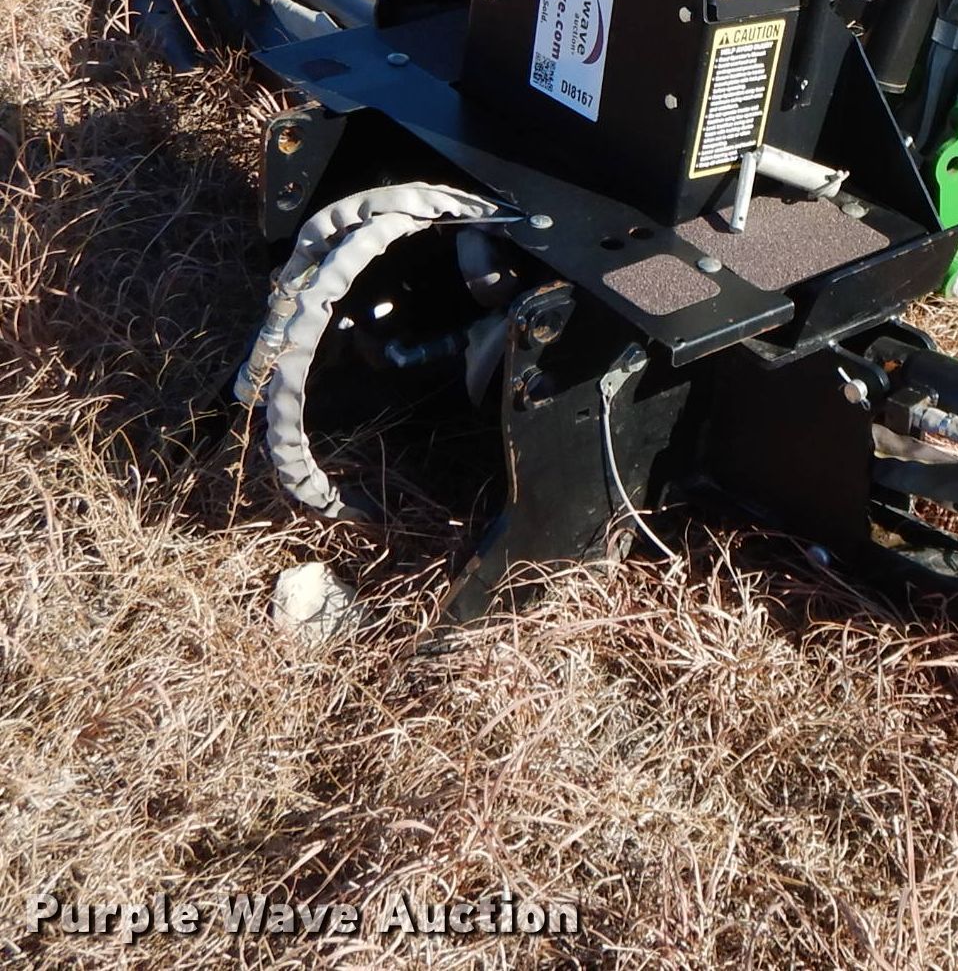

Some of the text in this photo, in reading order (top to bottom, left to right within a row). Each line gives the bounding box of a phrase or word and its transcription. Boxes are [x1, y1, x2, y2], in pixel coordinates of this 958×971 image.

[577, 1, 592, 56] wave
[733, 24, 781, 43] CAUTION
[561, 80, 593, 108] DI8167
